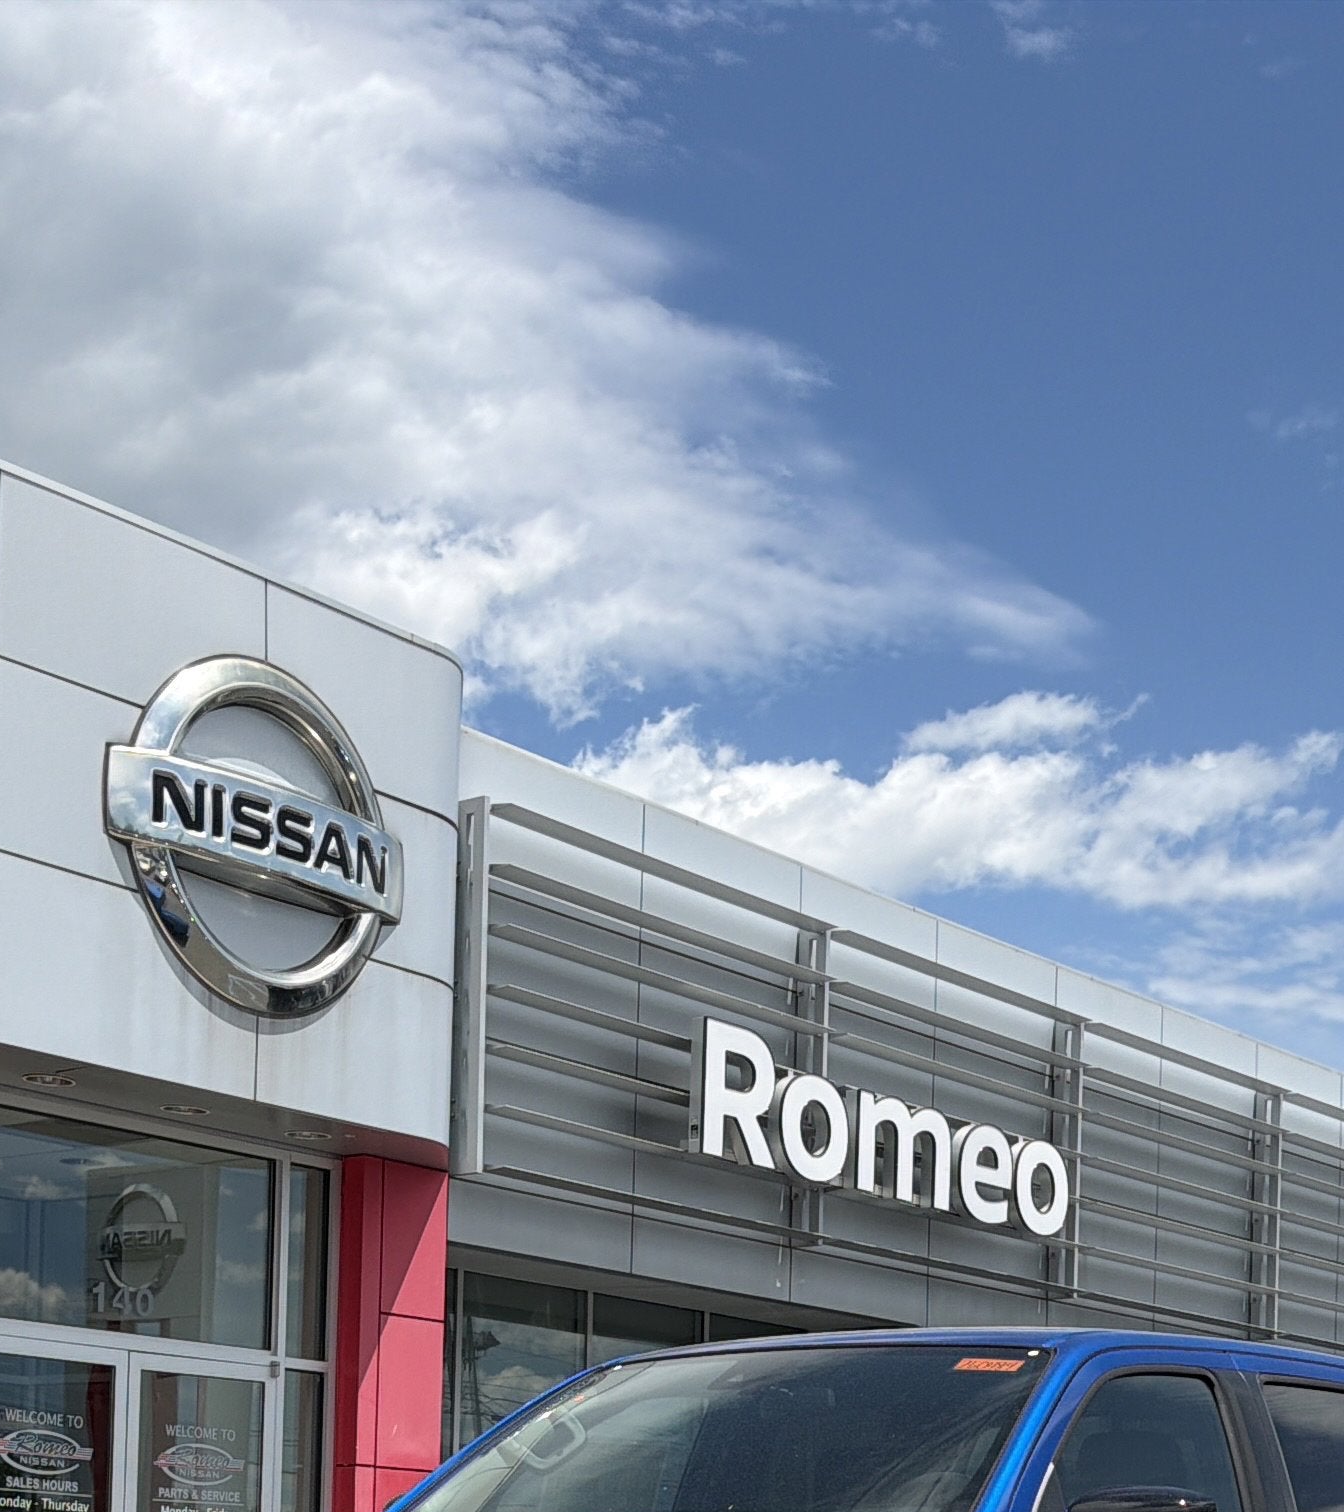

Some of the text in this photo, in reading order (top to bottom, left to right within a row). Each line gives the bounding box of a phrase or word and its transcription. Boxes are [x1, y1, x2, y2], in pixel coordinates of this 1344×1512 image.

[151, 767, 389, 899] NISSAN
[698, 1016, 1069, 1237] Romeo
[93, 1281, 155, 1317] 140
[5, 1408, 84, 1429] WELCOME TO
[165, 1424, 236, 1442] WELCOME TO
[11, 1432, 77, 1457] Romeo
[19, 1456, 66, 1468] NISSAN
[179, 1468, 221, 1479] NISSAN
[6, 1475, 79, 1493] SALES HOURS
[158, 1487, 240, 1502] PARTS & SERVICE
